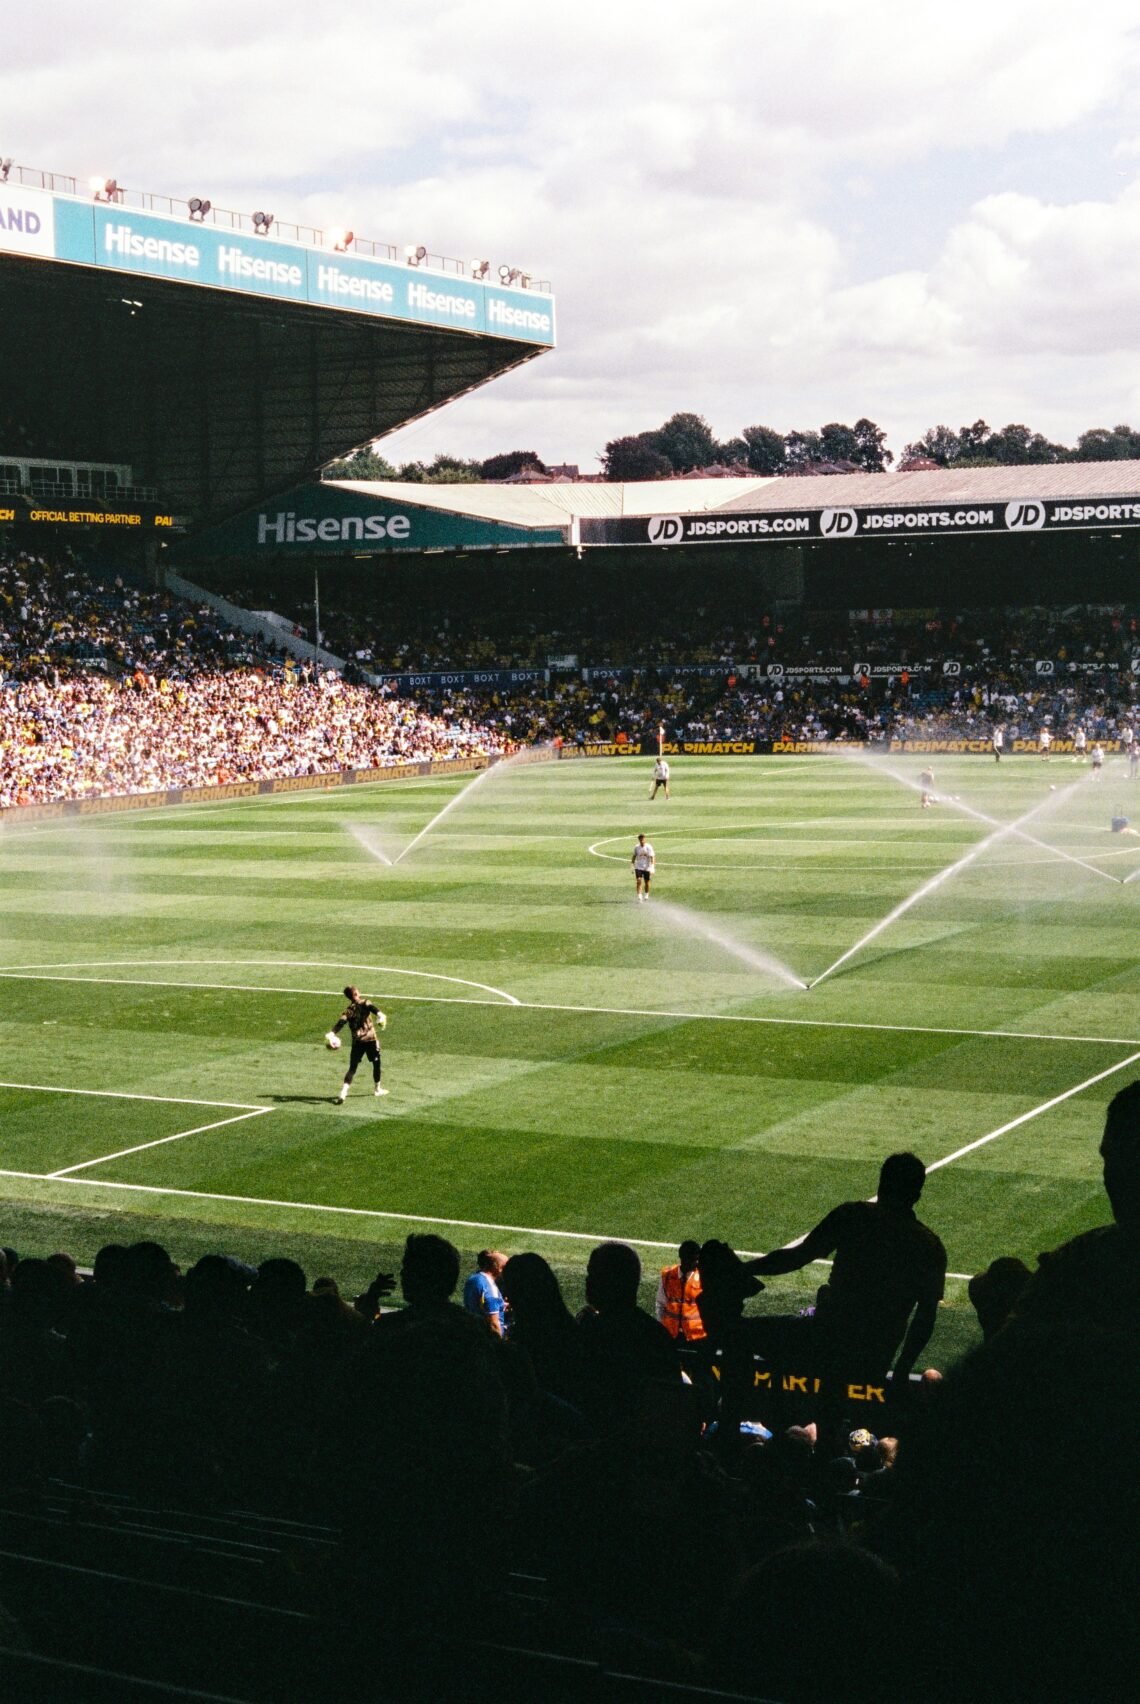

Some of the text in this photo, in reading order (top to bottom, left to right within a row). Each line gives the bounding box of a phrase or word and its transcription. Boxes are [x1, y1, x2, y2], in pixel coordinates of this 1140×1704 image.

[104, 222, 550, 331] Hisense Hisense Hisense Hisense Hisense
[30, 510, 68, 523] OFFICIAL
[69, 511, 104, 524] BETTING
[105, 513, 141, 526] PARTNER
[257, 511, 411, 544] Hisense
[652, 518, 680, 541] JD
[686, 517, 809, 536] JDSPORTS.COM
[825, 511, 854, 534] JD
[862, 510, 994, 530] JDSPORTS.COM
[1009, 504, 1041, 527] JD
[409, 676, 431, 686] BOXT
[440, 675, 465, 684] BOXT
[473, 673, 500, 683] BOXT
[511, 672, 539, 682] BOXT
[785, 665, 843, 674] JDSPORTS.COM
[889, 740, 993, 753] PARIMATCH
[181, 782, 260, 803] PARIMATCH
[272, 772, 343, 793] PARIMATCH
[355, 764, 420, 783] PARIMATCH
